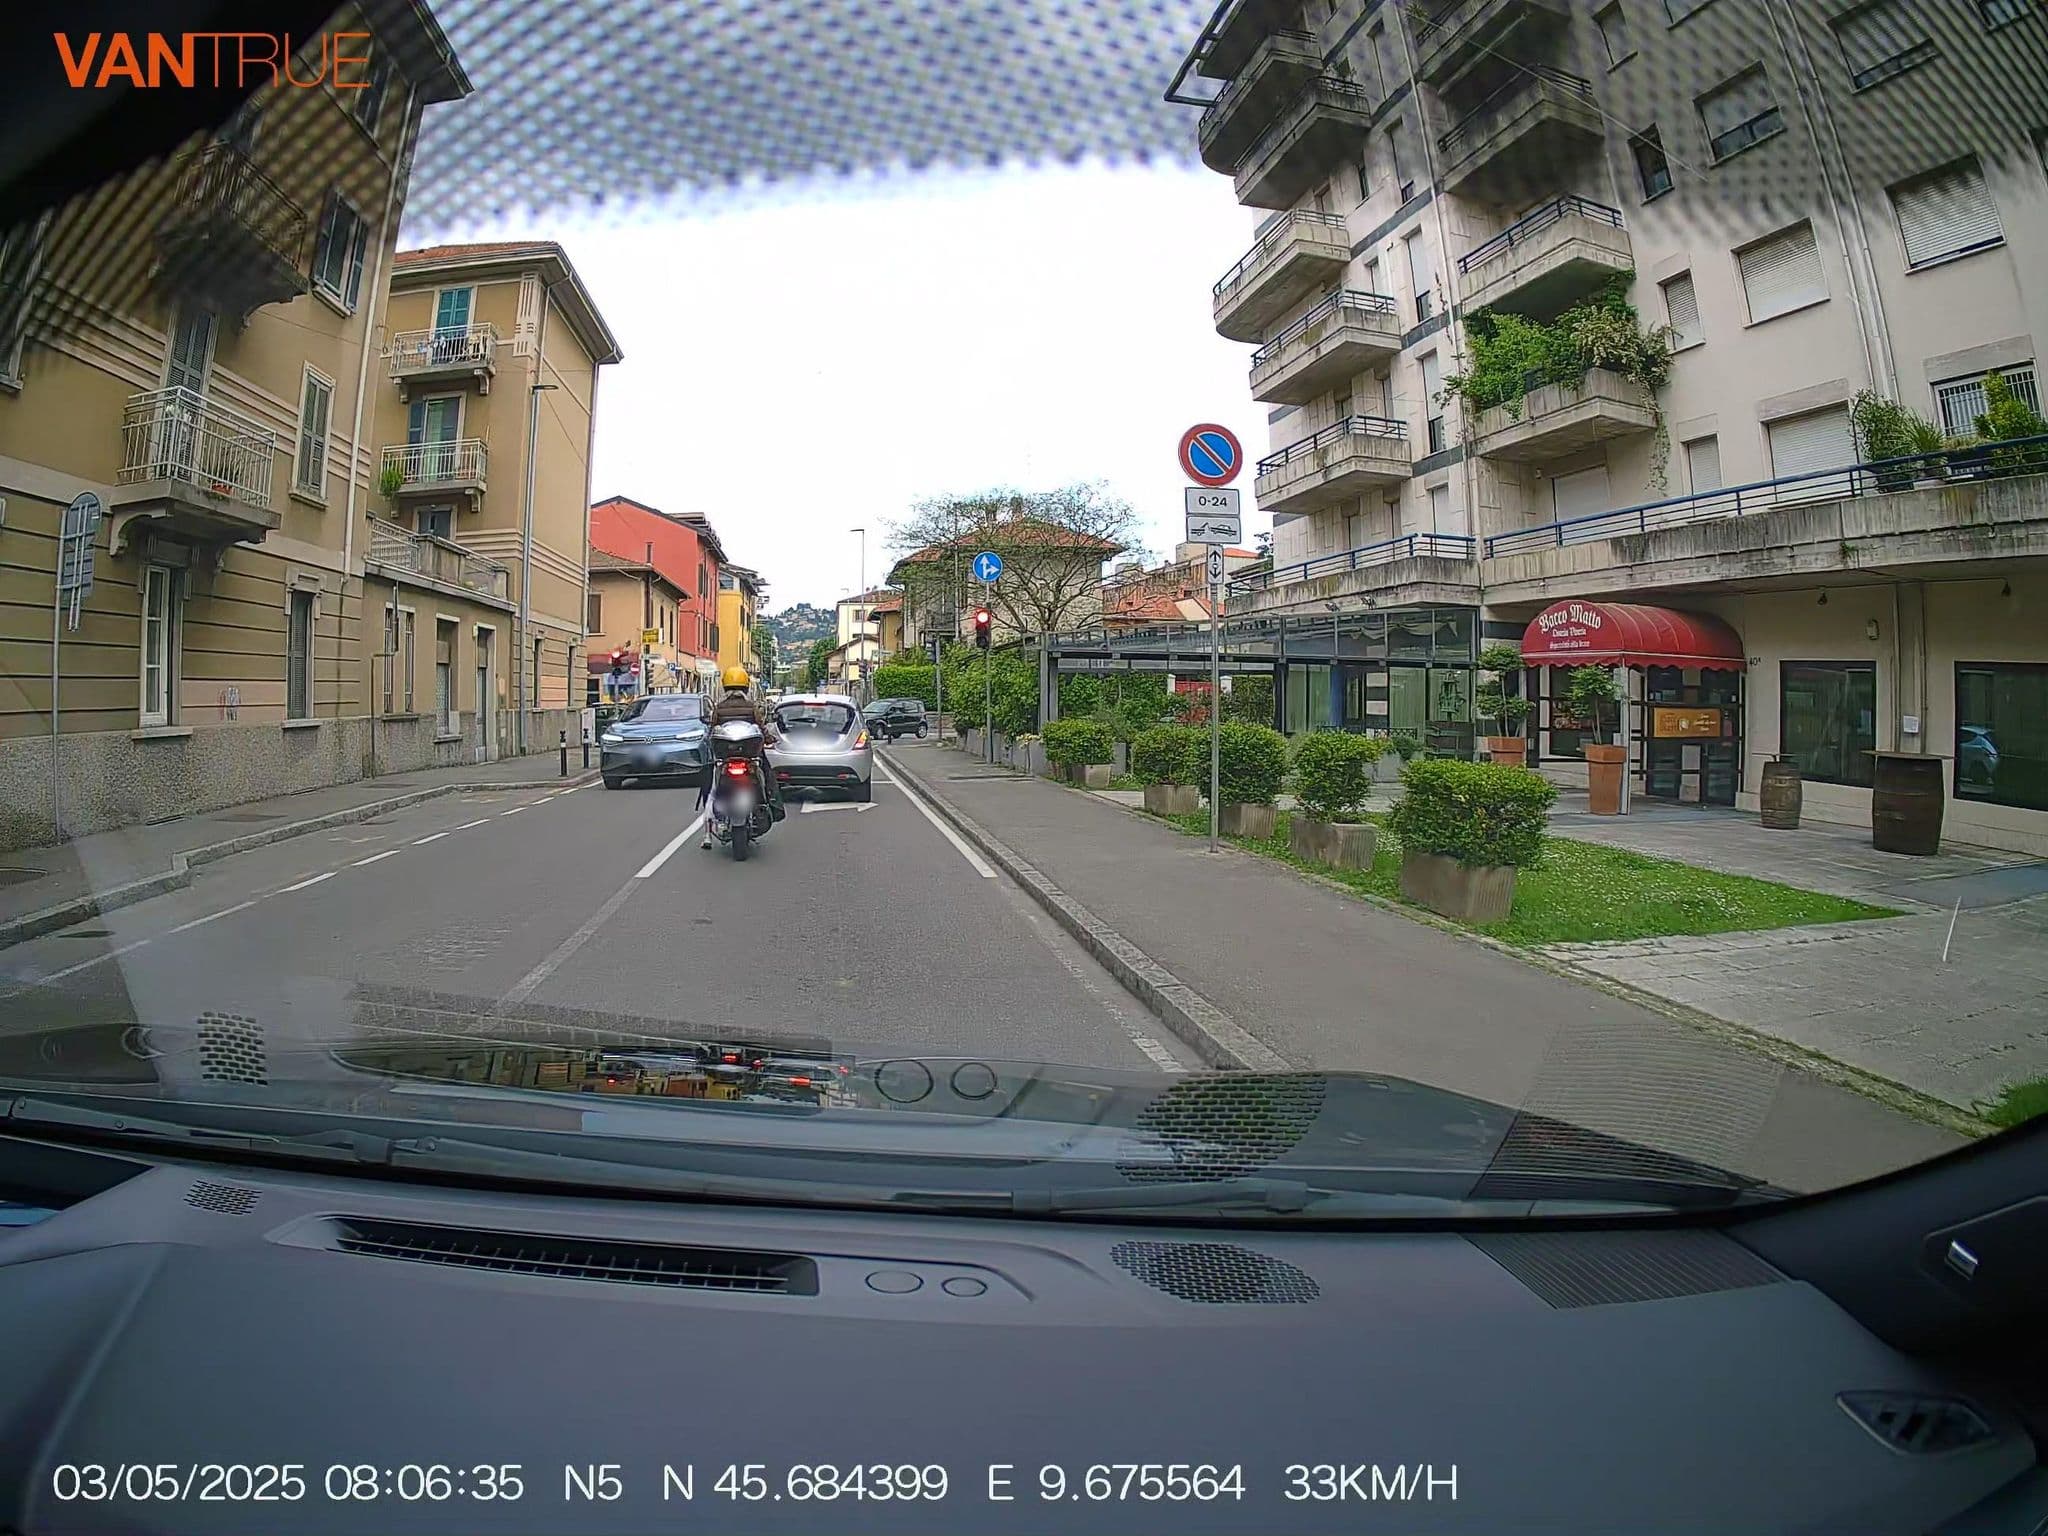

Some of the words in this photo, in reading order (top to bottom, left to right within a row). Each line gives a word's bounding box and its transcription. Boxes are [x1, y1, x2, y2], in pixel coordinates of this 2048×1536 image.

[1198, 495, 1227, 507] 0-24
[1539, 610, 1568, 634] Bacco
[1569, 604, 1601, 629] Matto
